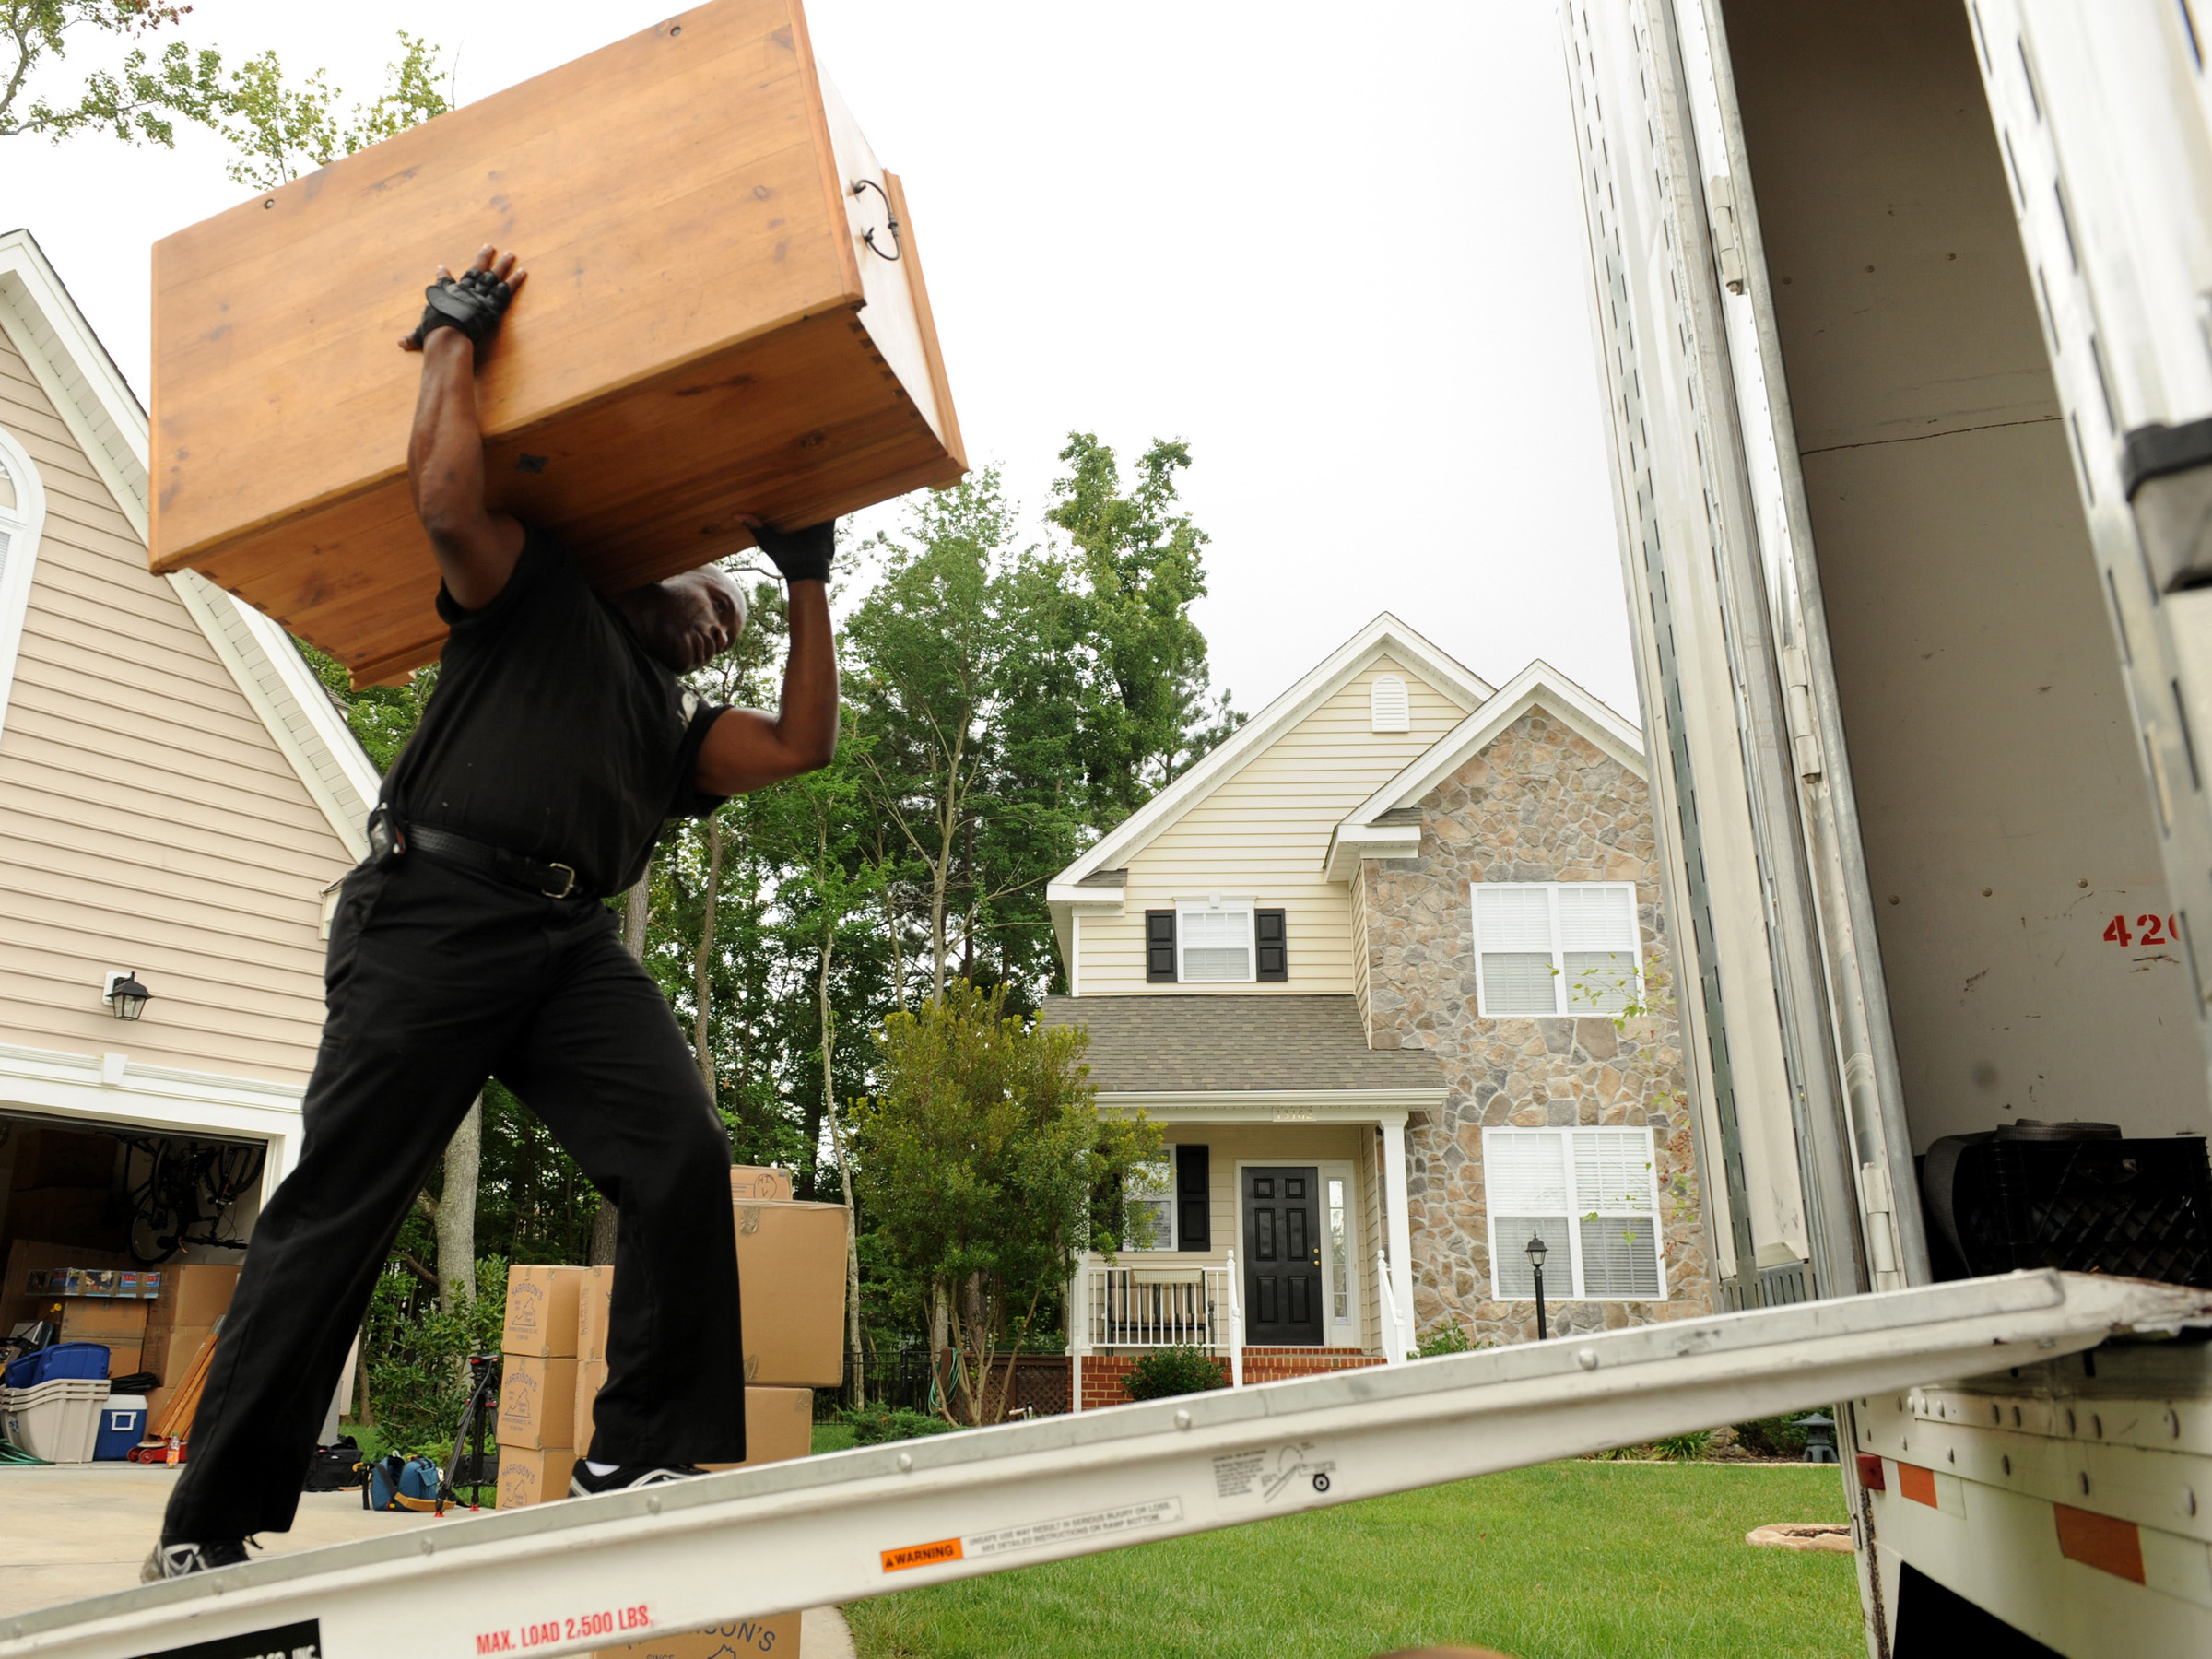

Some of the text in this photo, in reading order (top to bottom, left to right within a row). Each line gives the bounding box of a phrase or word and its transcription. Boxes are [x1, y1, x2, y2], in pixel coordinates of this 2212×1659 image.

[501, 1463, 536, 1485] HARRISON'S
[982, 1543, 995, 1552] SEE
[998, 1536, 1032, 1550] DETAILED
[1035, 1526, 1088, 1543] INSTRUCTIONS
[1090, 1524, 1101, 1533] ON
[1103, 1520, 1124, 1530] RAMP
[1000, 1531, 1014, 1540] USE
[1033, 1524, 1061, 1534] RESULT
[1073, 1514, 1104, 1526] SERIOUS
[1106, 1510, 1134, 1521] INJURY
[1135, 1506, 1147, 1515] OR
[895, 1545, 954, 1566] WARNING
[476, 1630, 516, 1656] MAX.
[521, 1621, 560, 1648] LOAD
[565, 1611, 613, 1641] 2,500
